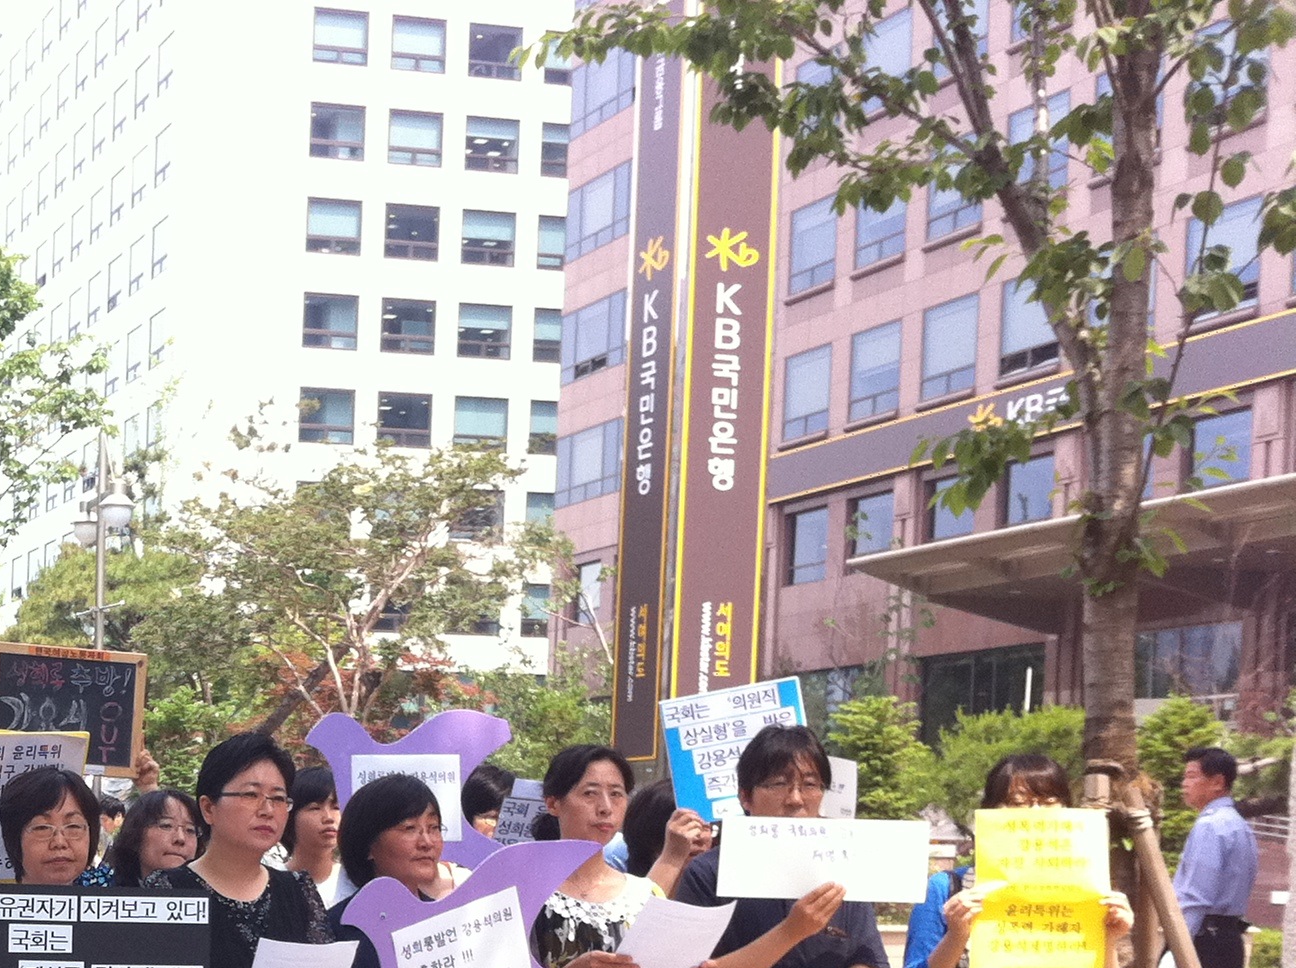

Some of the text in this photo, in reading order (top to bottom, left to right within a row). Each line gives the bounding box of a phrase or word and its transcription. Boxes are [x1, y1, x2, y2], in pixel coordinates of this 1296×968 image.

[636, 289, 659, 495] KB국민은행
[708, 282, 743, 491] KB국민은행
[665, 703, 710, 723] 국회는
[99, 701, 122, 763] OUT
[13, 744, 62, 760] 윤리특위
[503, 801, 530, 817] 국회
[83, 898, 158, 920] 지켜보고
[166, 900, 206, 922] 있다!
[11, 929, 68, 951] 국회는
[402, 906, 513, 960] 성희롱발언 강용석의원
